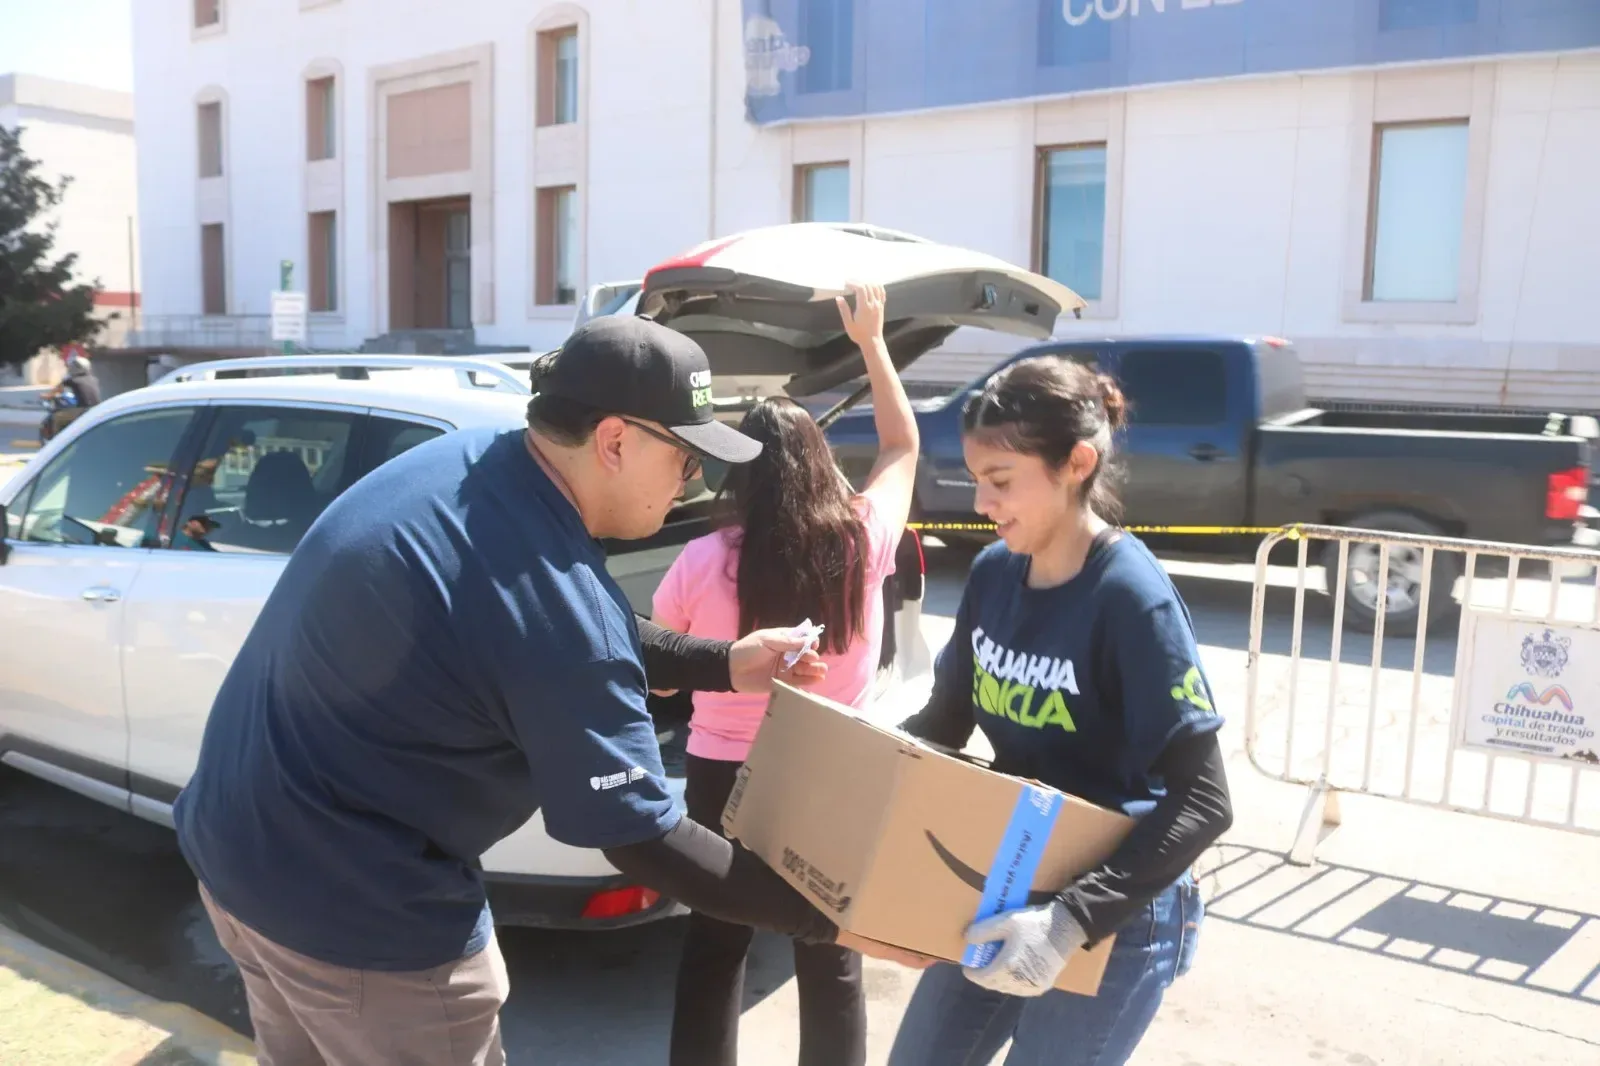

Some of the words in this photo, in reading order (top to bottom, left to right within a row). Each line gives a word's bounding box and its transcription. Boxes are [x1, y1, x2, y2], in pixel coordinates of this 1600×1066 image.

[1493, 703, 1585, 725] Chihuahua
[1481, 714, 1526, 728] capital
[1529, 720, 1545, 731] de
[1547, 723, 1595, 738] trabajo
[1495, 727, 1503, 737] y
[1505, 728, 1577, 746] resultados
